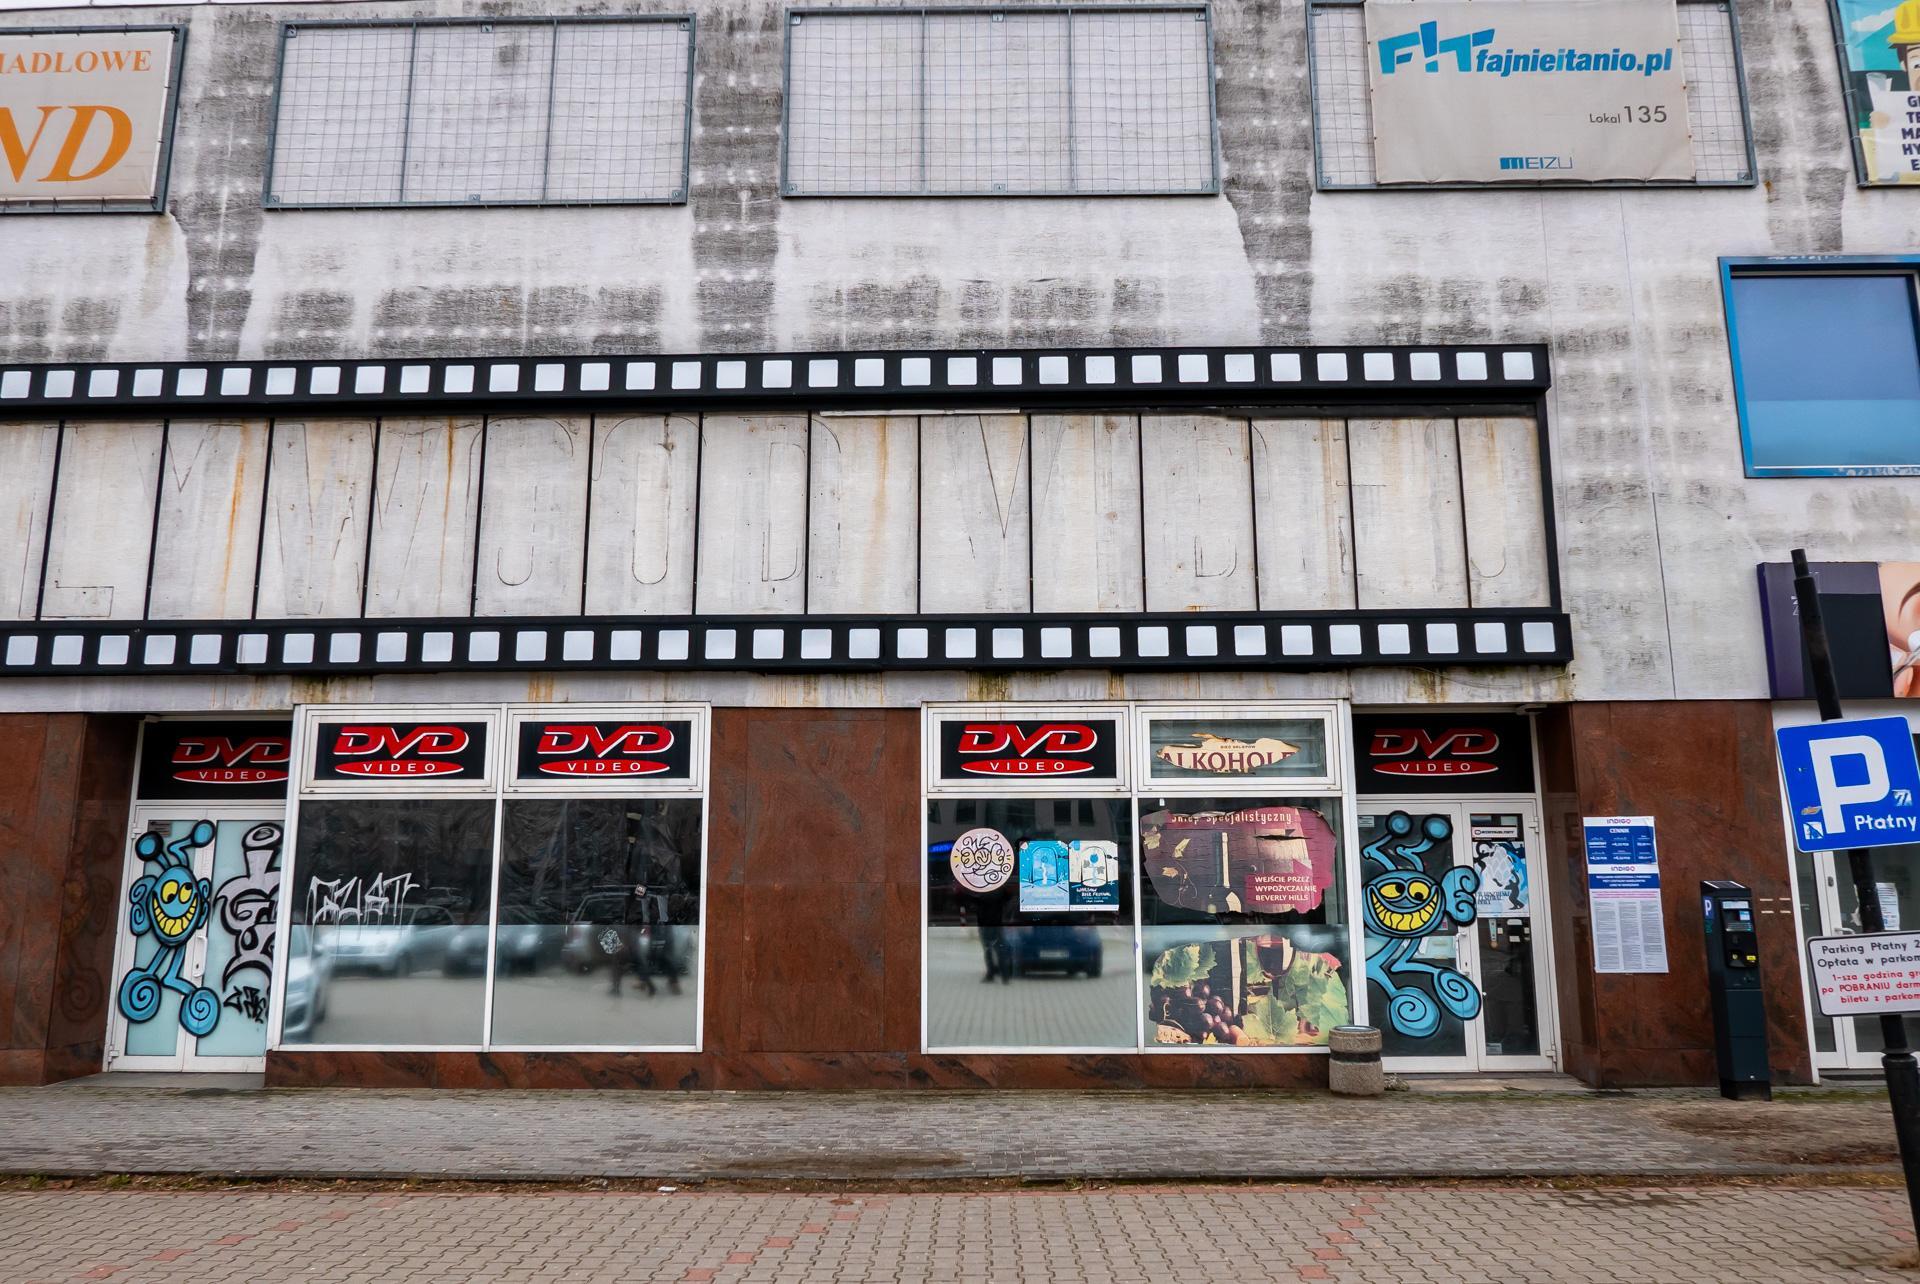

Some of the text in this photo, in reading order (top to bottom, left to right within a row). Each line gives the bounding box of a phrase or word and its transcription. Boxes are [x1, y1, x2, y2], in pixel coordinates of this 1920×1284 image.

[1475, 48, 1673, 77] fajnieitanio.pl
[1907, 95, 1920, 108] G
[1589, 105, 1668, 124] Lokal 135
[1500, 157, 1573, 170] MEIZU
[333, 725, 469, 760] DVD
[537, 724, 675, 759] DVD
[958, 723, 1098, 758] DVD
[1370, 728, 1500, 760] DVD
[172, 736, 291, 767] DVD
[362, 763, 437, 773] VIDEO
[567, 762, 642, 772] VIDEO
[989, 761, 1065, 772] VIDEO
[1400, 762, 1471, 772] VIDEO
[199, 771, 267, 780] VIDEO
[1808, 735, 1890, 834] P
[1854, 814, 1917, 832] Płatny
[1254, 875, 1310, 884] WEJŚCIE PRZEZ
[1255, 884, 1317, 894] WYPOŻYCZALNIĘ
[1255, 894, 1309, 902] BEVERLY HILLS
[1821, 944, 1865, 955] Parking
[1871, 942, 1907, 952] Płatny
[1817, 957, 1859, 969] Opłata
[1832, 970, 1920, 982] 1-sza godzina gr
[1822, 987, 1834, 996] po
[1839, 982, 1890, 992] POBRANIU
[1840, 994, 1869, 1004] biletu
